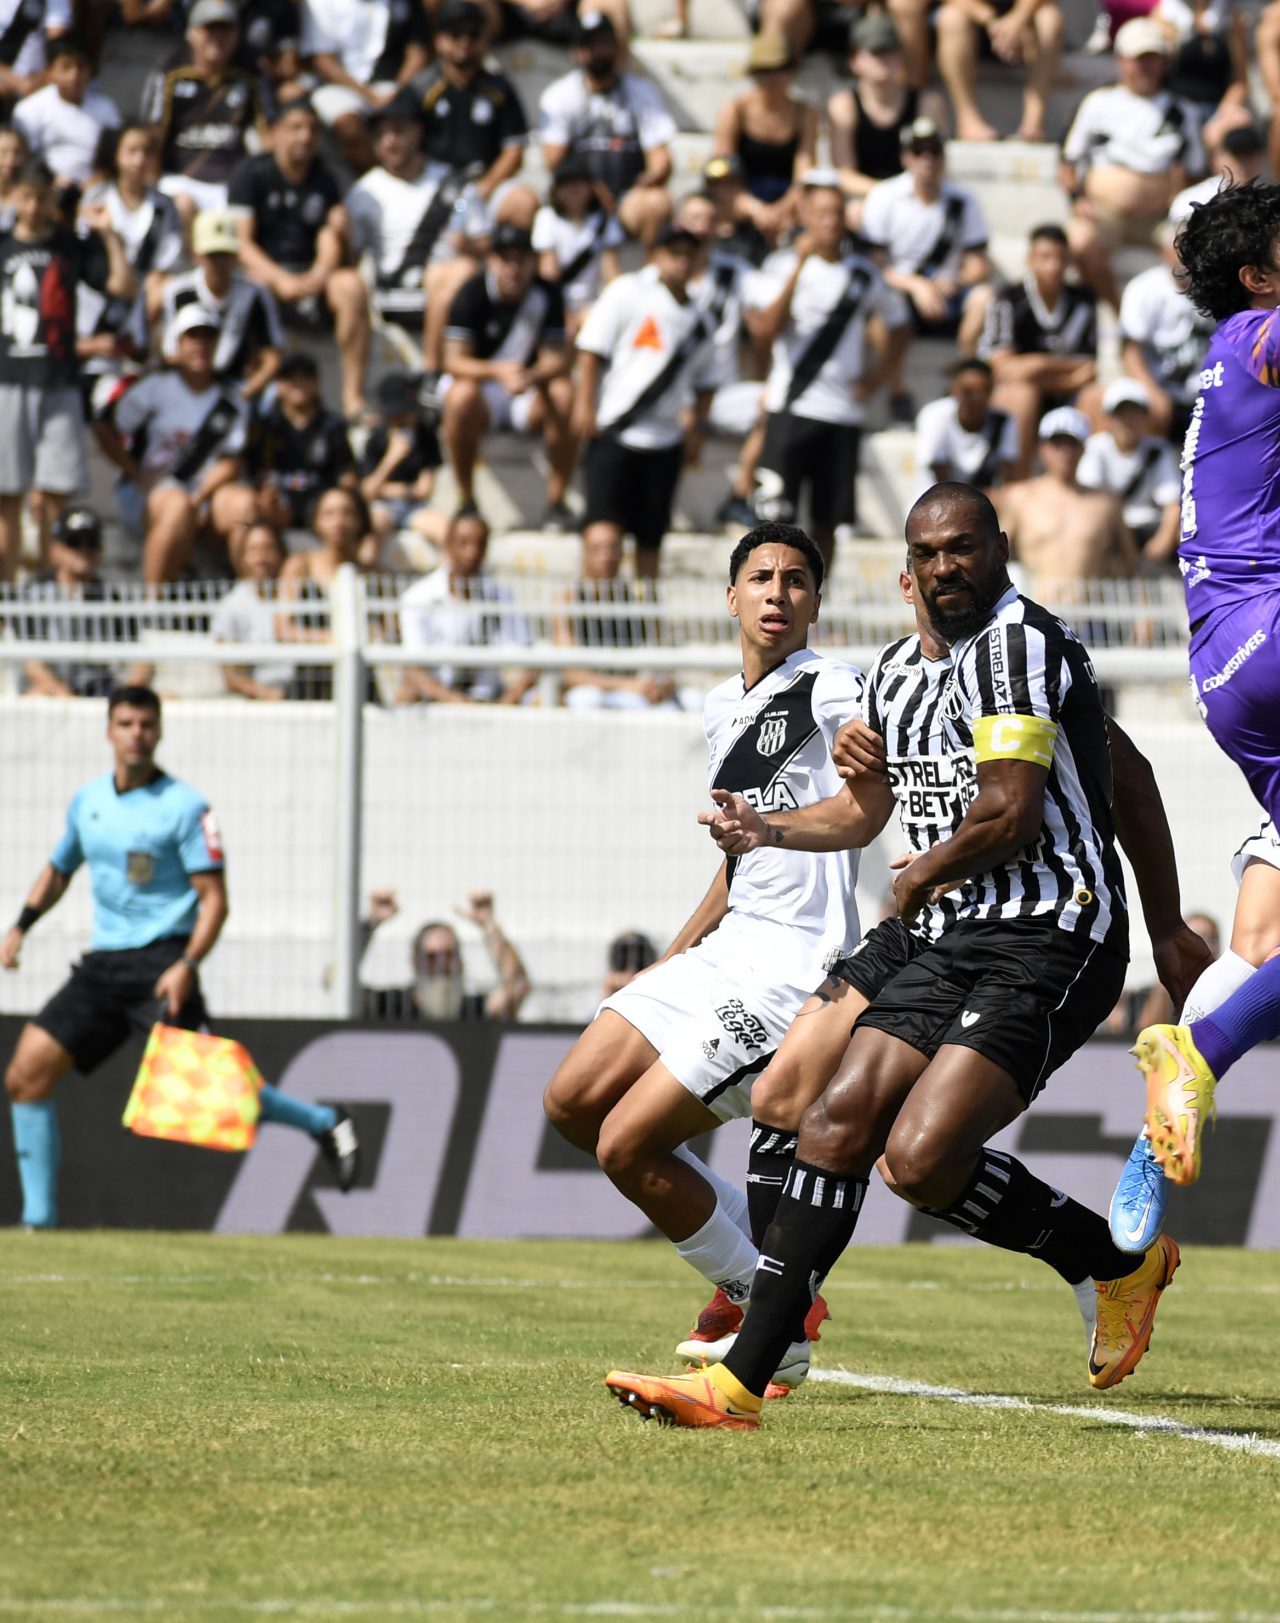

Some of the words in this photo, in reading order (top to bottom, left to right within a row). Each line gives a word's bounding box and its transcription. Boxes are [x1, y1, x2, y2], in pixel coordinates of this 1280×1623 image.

[988, 627, 1007, 693] ESTRELA
[991, 719, 1023, 752] C
[908, 790, 951, 818] BET
